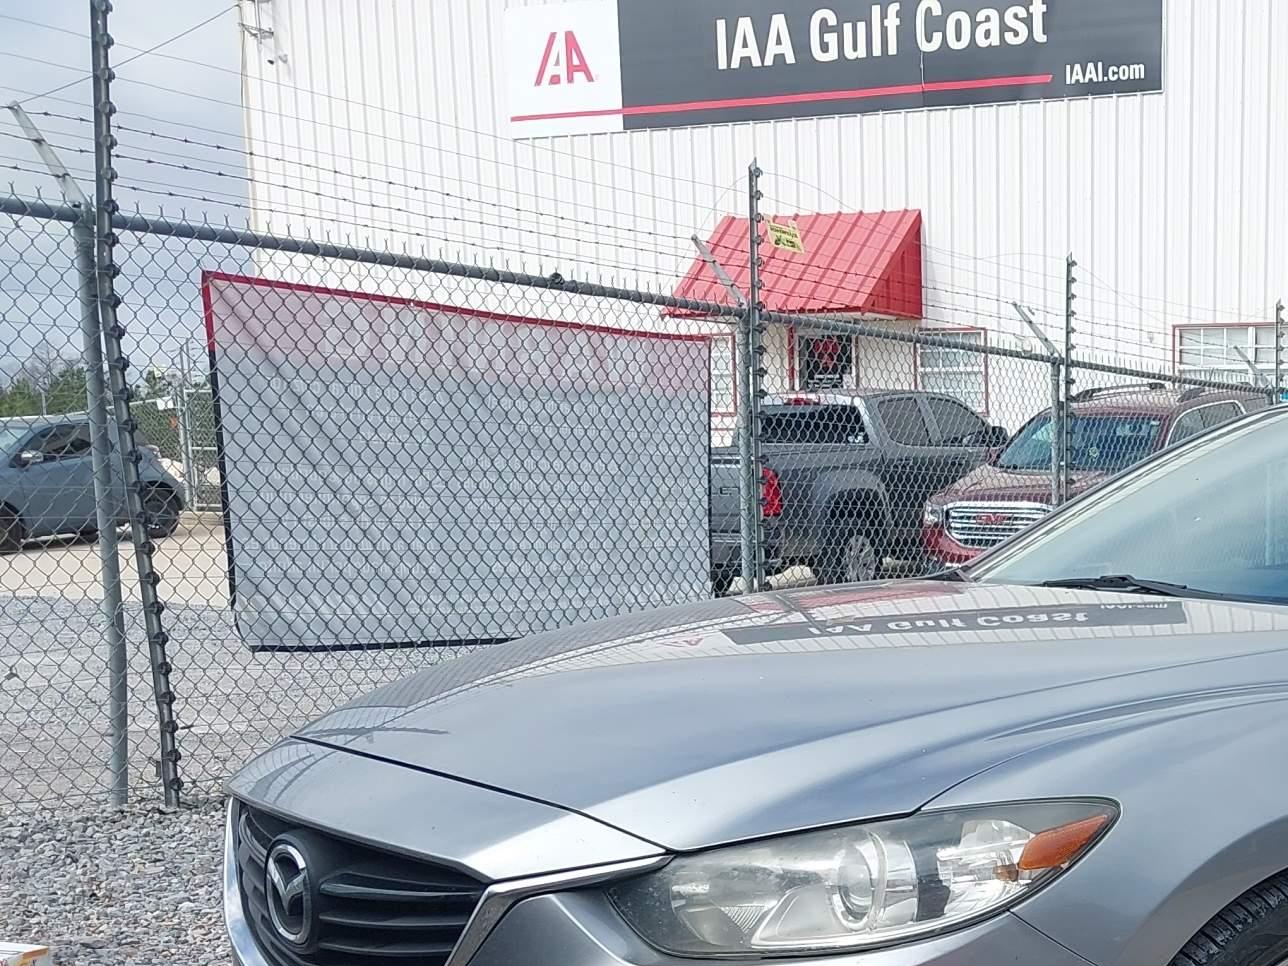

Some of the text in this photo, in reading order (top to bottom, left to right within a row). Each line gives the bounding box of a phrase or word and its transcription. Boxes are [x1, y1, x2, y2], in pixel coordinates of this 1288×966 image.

[717, 0, 1048, 69] IAA Gulf Coast
[1065, 61, 1145, 85] IAAI.com
